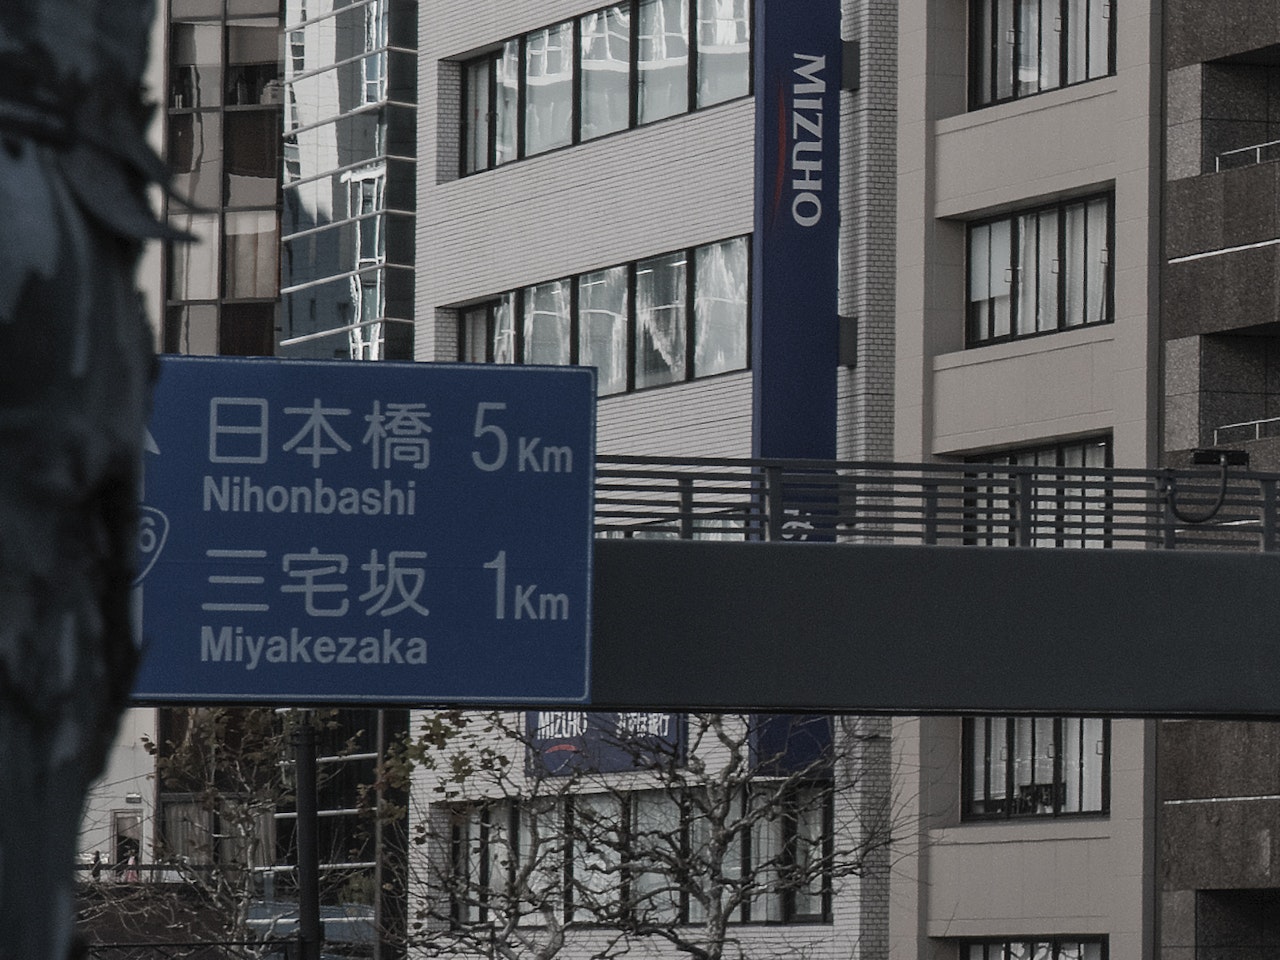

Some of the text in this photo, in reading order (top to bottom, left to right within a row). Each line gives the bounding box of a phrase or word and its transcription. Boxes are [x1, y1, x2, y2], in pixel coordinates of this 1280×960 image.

[791, 52, 827, 228] MIZUHO
[209, 397, 432, 470] 日本橋
[203, 475, 416, 515] Nihonbashi
[201, 547, 430, 617] 三宅坂
[201, 625, 428, 670] Miyakezaka
